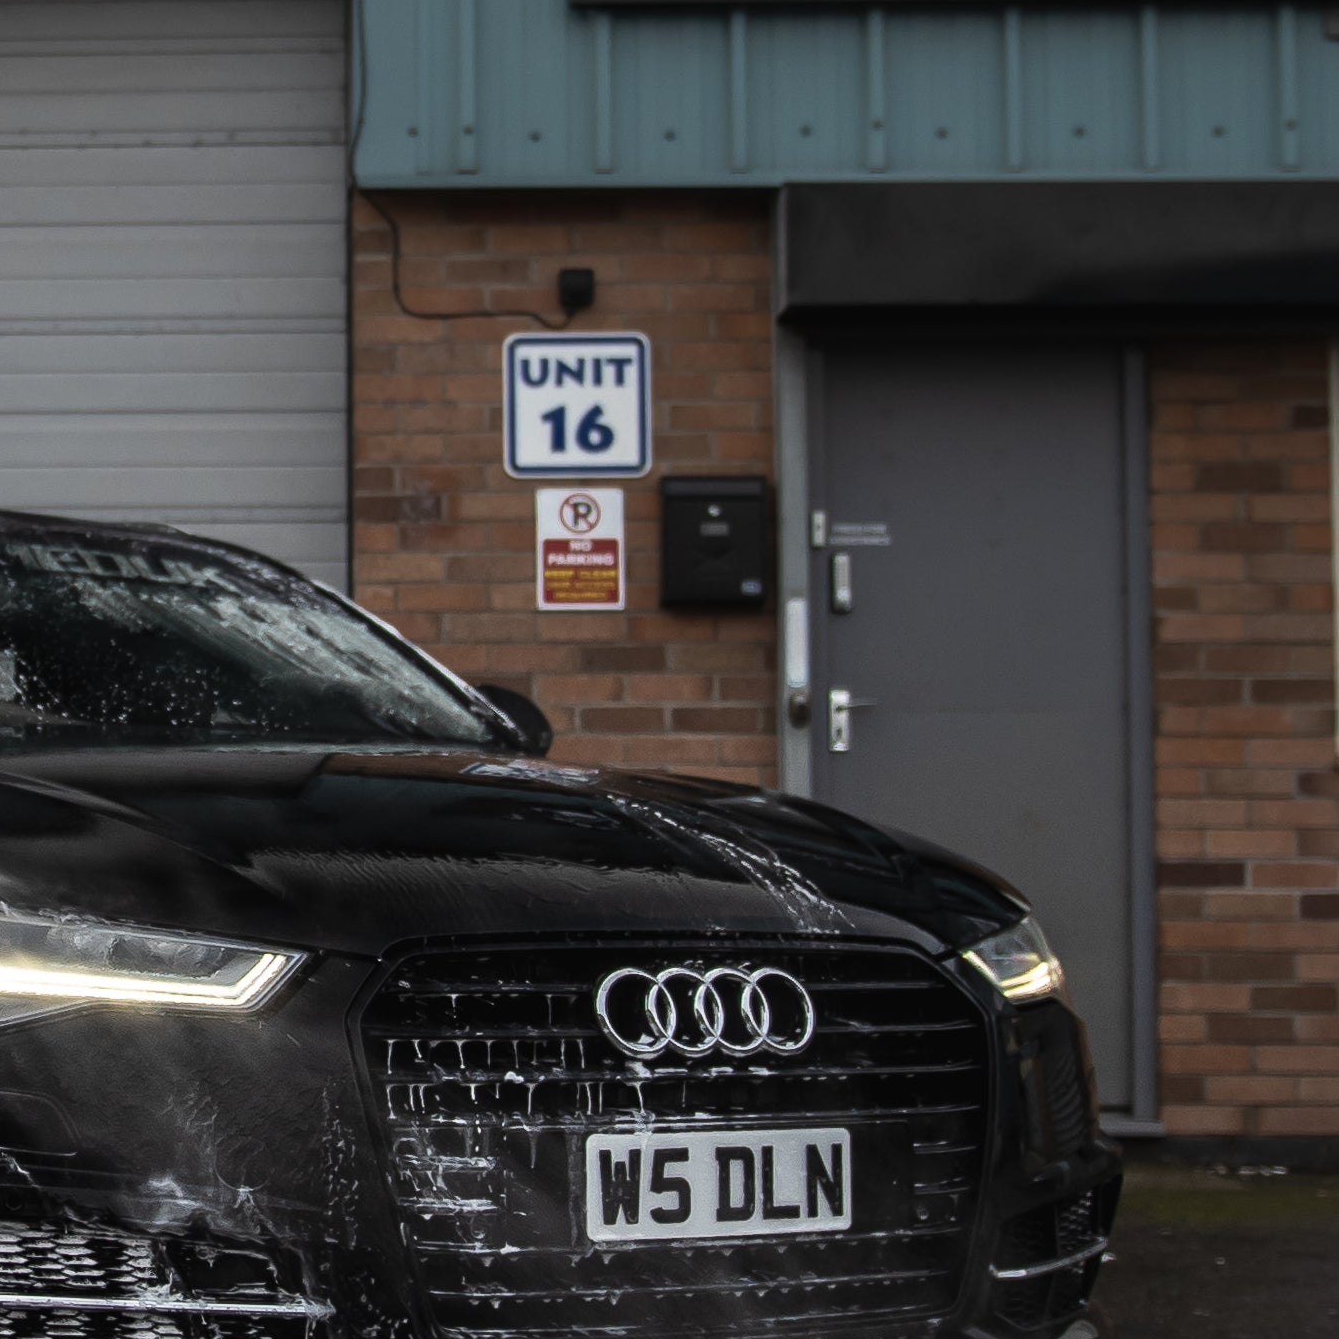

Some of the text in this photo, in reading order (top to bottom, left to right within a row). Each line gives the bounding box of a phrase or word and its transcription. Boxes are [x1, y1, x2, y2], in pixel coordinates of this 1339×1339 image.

[519, 356, 633, 389] UNIT
[540, 404, 615, 454] 16
[598, 1142, 845, 1226] W5 DLN
